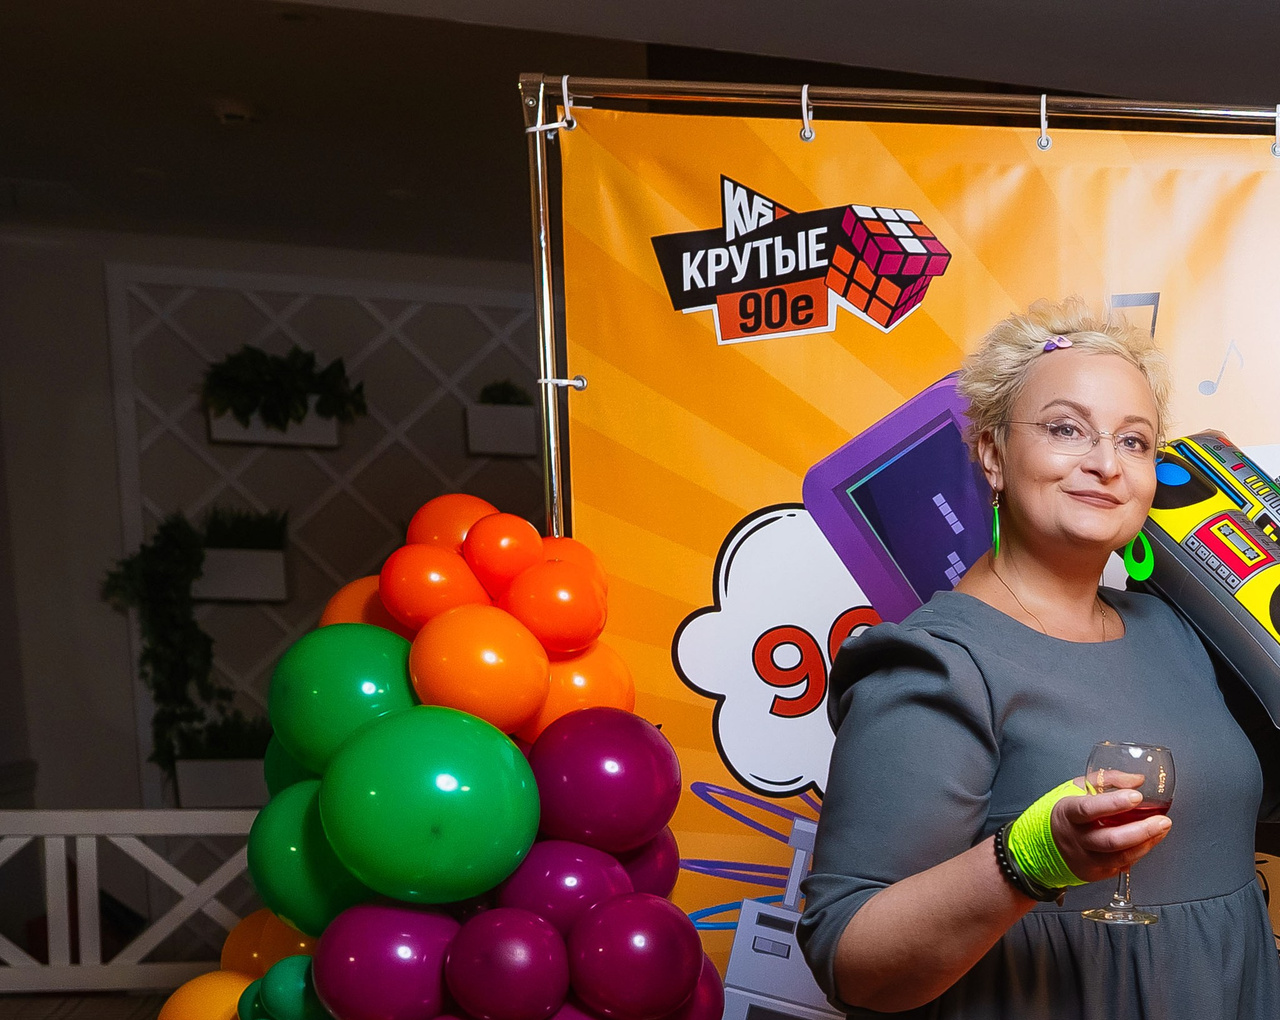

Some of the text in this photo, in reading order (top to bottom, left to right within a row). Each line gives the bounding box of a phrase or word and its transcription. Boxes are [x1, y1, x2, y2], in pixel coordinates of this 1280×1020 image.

[682, 226, 829, 292] КРУТЫЕ
[738, 288, 814, 334] 90е
[752, 605, 883, 719] 9
